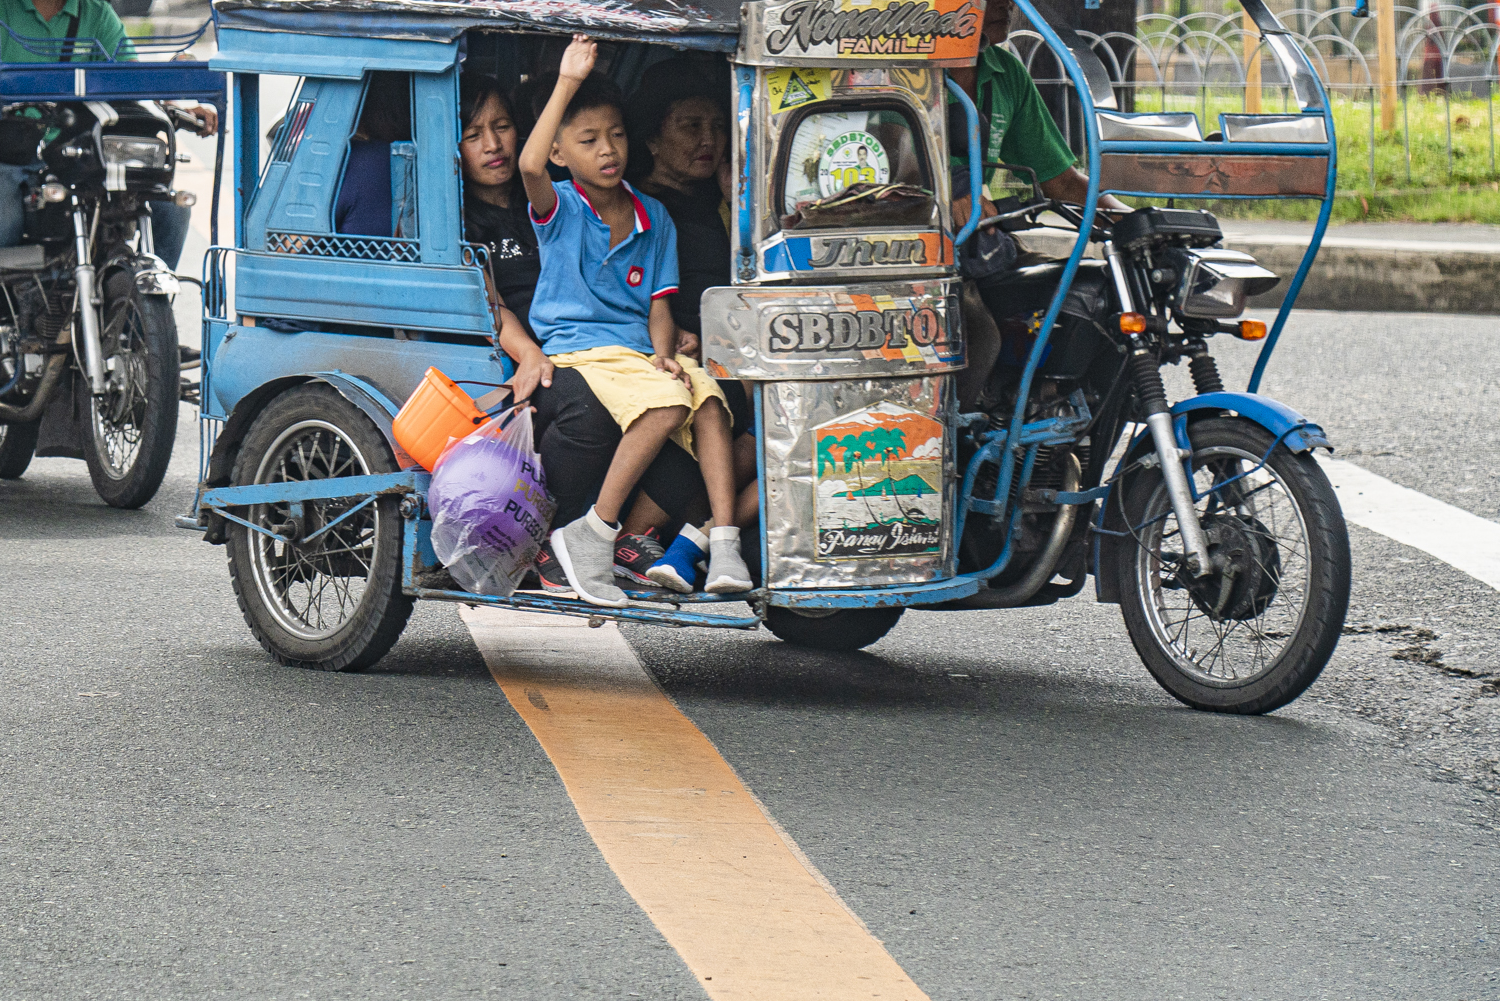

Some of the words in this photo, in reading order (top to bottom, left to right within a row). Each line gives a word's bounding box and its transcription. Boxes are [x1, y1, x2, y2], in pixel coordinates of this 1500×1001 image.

[838, 37, 937, 54] FAMILY
[826, 132, 885, 158] SBDBTODI
[830, 167, 876, 193] 103
[808, 237, 928, 268] Jhun
[769, 308, 950, 353] SBDBTO
[818, 529, 887, 554] Panay
[889, 521, 940, 549] Island
